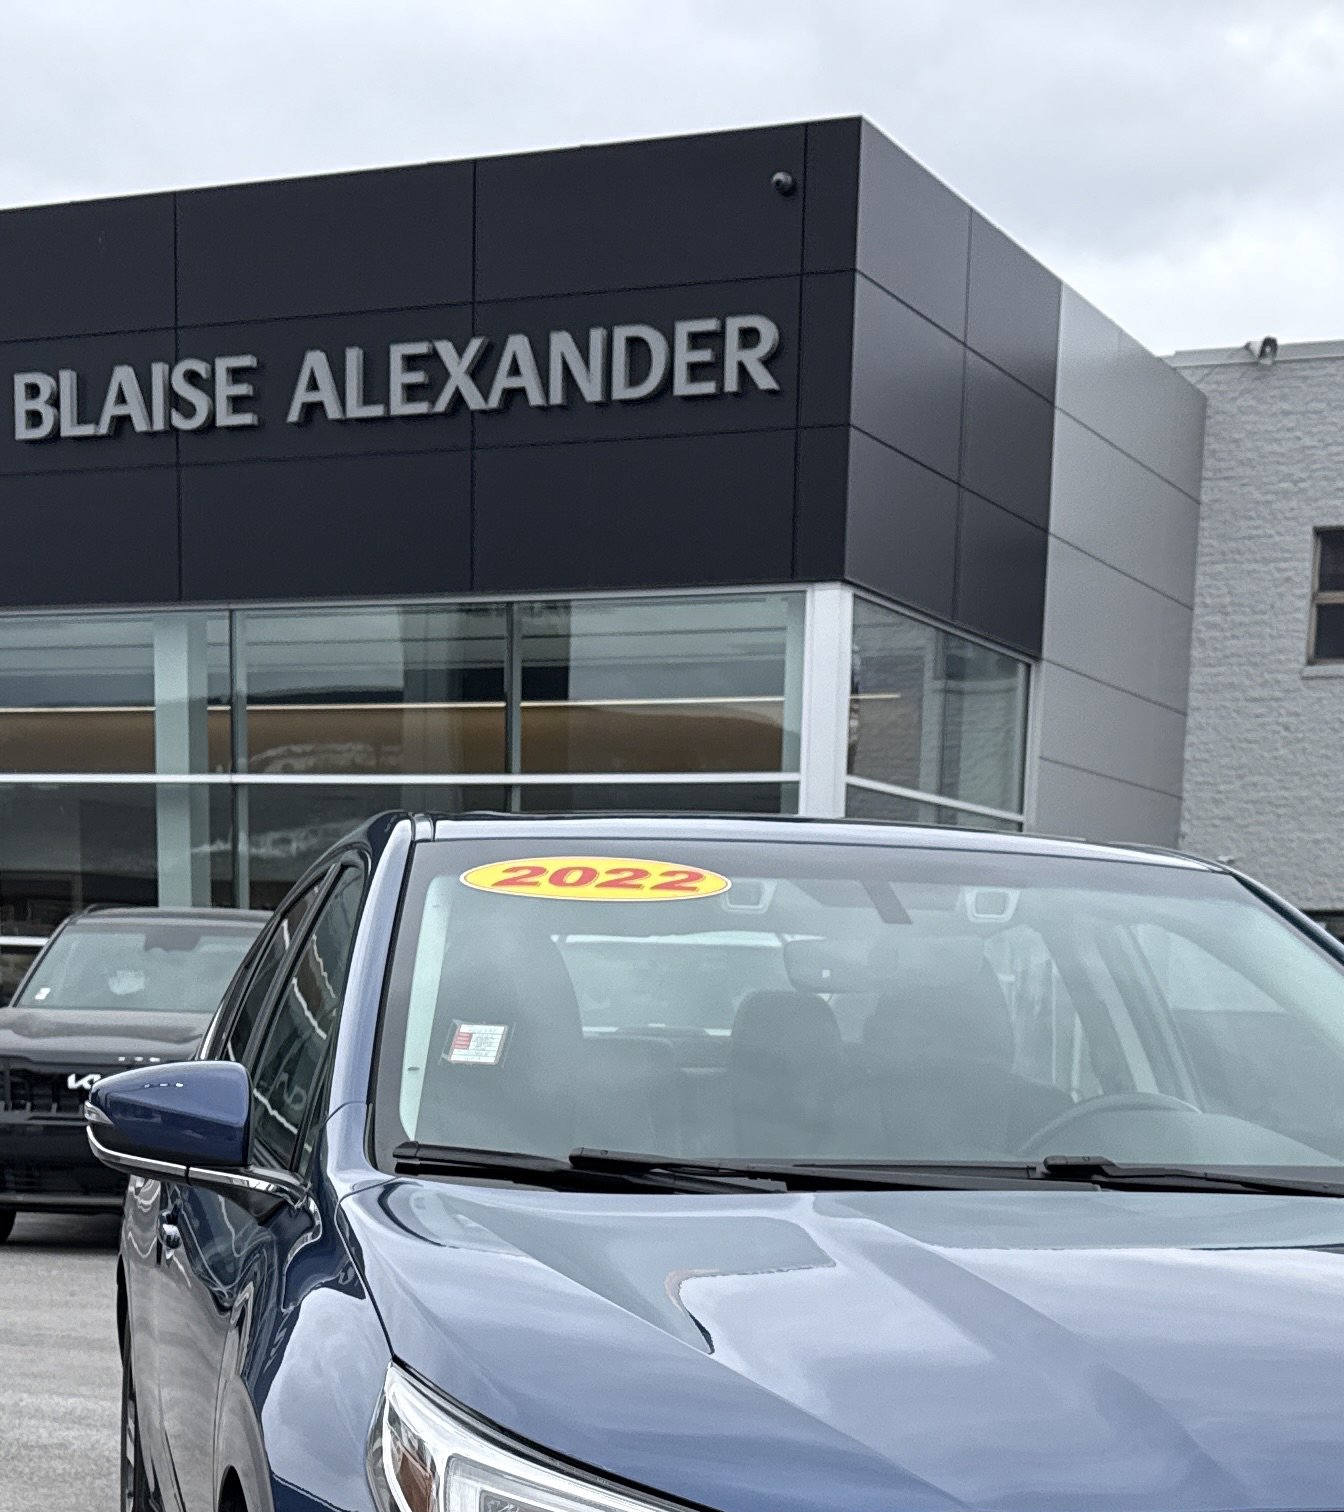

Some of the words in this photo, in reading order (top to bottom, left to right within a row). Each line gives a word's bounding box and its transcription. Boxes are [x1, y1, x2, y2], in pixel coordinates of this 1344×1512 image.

[14, 354, 258, 441] BLAISE
[286, 314, 781, 423] ALEXANDER
[491, 865, 707, 892] 2022
